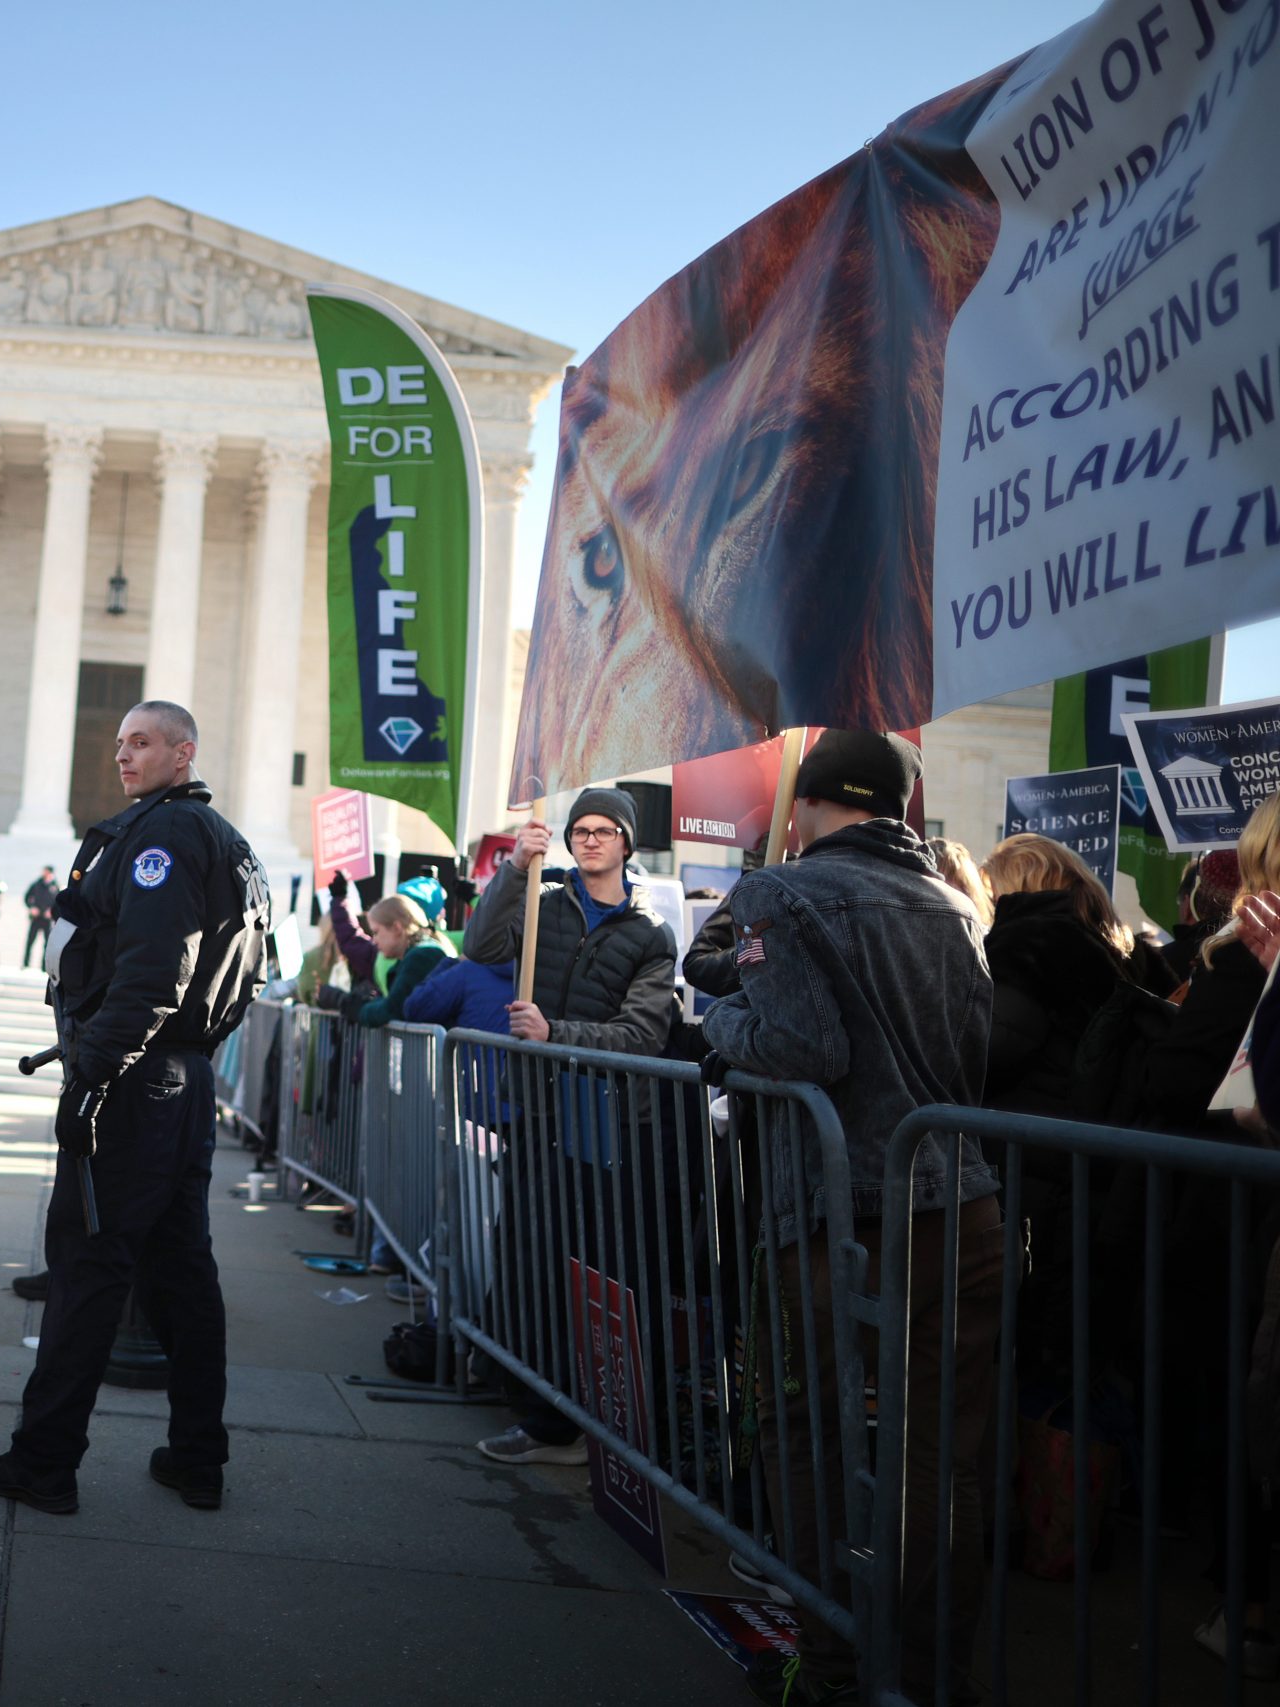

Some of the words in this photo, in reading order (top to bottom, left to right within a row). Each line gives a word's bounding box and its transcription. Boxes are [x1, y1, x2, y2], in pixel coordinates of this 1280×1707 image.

[1000, 76, 1094, 201] LION
[1100, 4, 1169, 103] OF
[1190, 0, 1250, 61] J
[1004, 197, 1089, 295] ARE
[1099, 70, 1223, 228] UPON
[1078, 162, 1204, 341] JUDGE
[962, 253, 1240, 463] ACCORDING
[336, 365, 428, 407] DE
[348, 426, 433, 459] FOR
[972, 468, 1031, 549] HIS
[1044, 416, 1190, 512] LAW,
[1208, 350, 1280, 460] AN
[373, 474, 418, 696] LIFE
[950, 568, 1032, 649] YOU
[1044, 519, 1162, 615] WILL
[1174, 728, 1229, 744] WOMEN
[1230, 751, 1280, 768] CONC
[1233, 766, 1280, 782] WOM
[1060, 784, 1110, 799] AMERICA
[1242, 797, 1269, 811] FO
[679, 816, 702, 834] LIVE
[704, 820, 735, 838] ACTION
[1011, 810, 1110, 832] SCIENCE
[728, 1603, 781, 1638] HUMAN
[760, 1605, 798, 1626] LIFE
